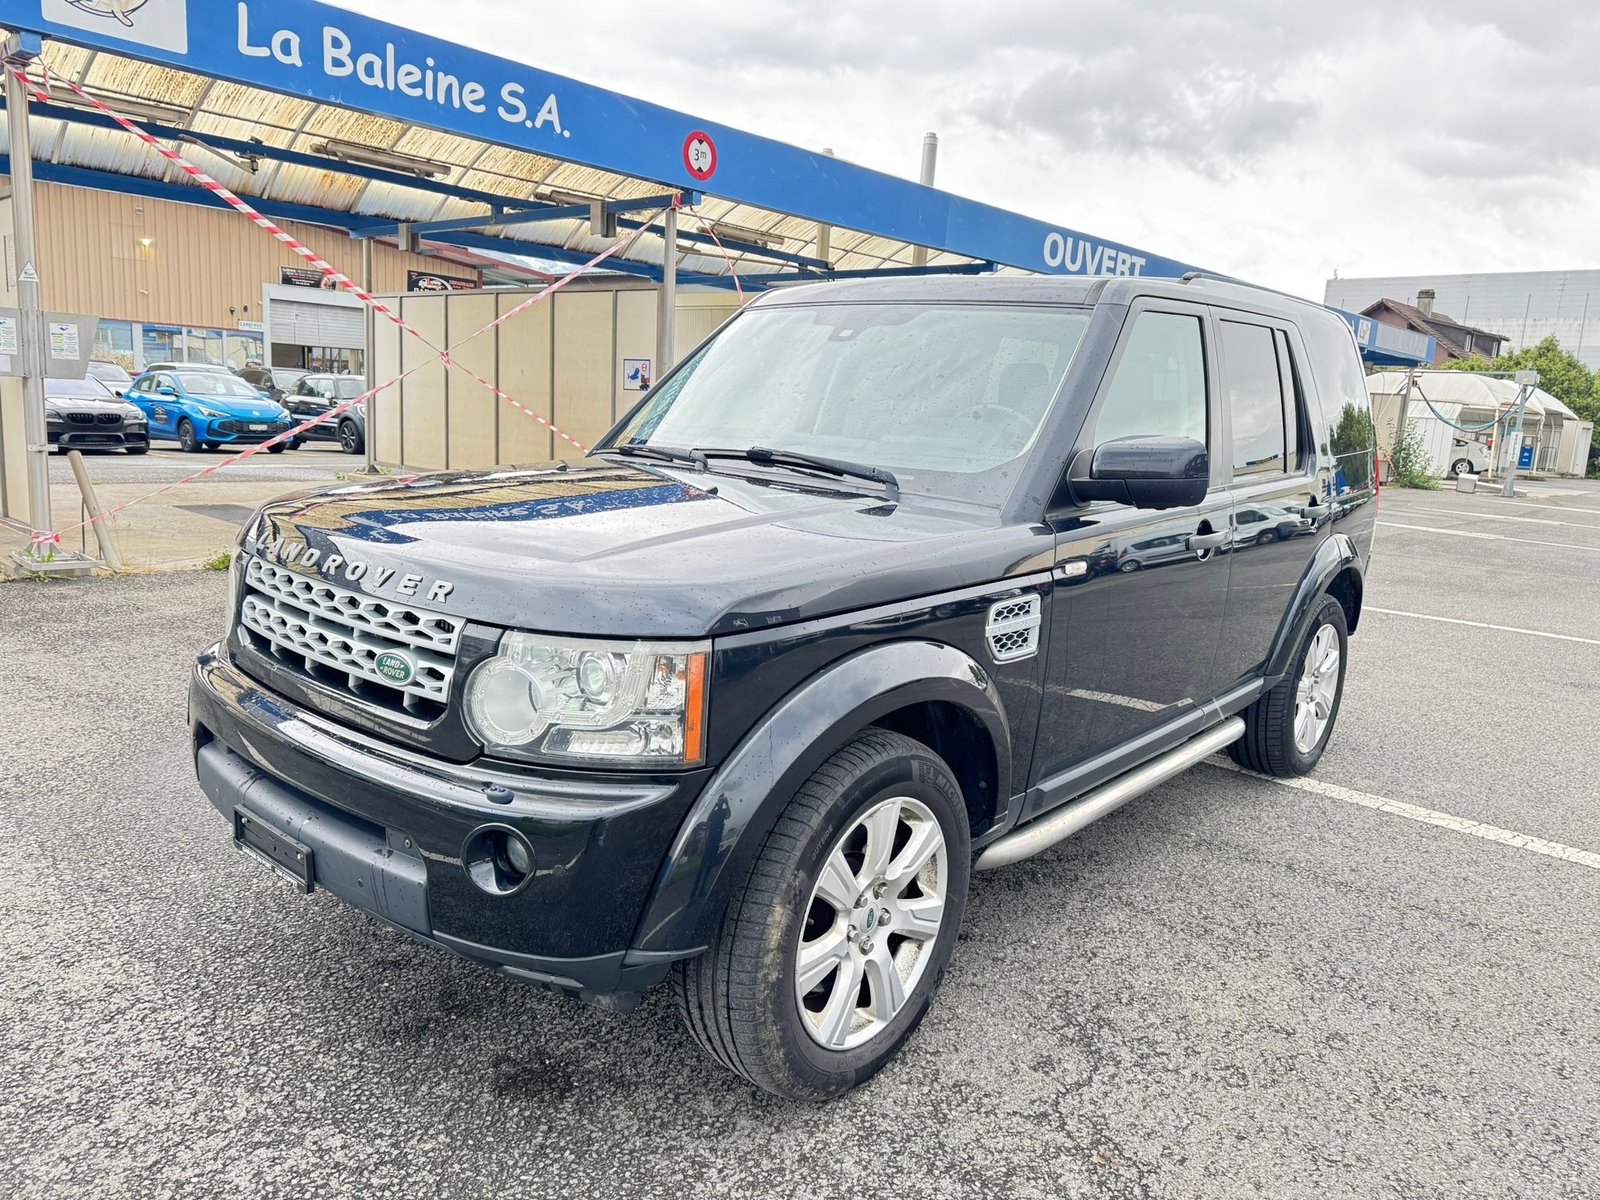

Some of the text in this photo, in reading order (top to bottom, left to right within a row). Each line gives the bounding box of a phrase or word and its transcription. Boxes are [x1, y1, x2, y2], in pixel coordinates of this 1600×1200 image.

[237, 2, 571, 138] La Baleine S.A.
[1043, 232, 1146, 276] OUVERT
[382, 657, 400, 669] LAND
[382, 665, 405, 679] ROVER
